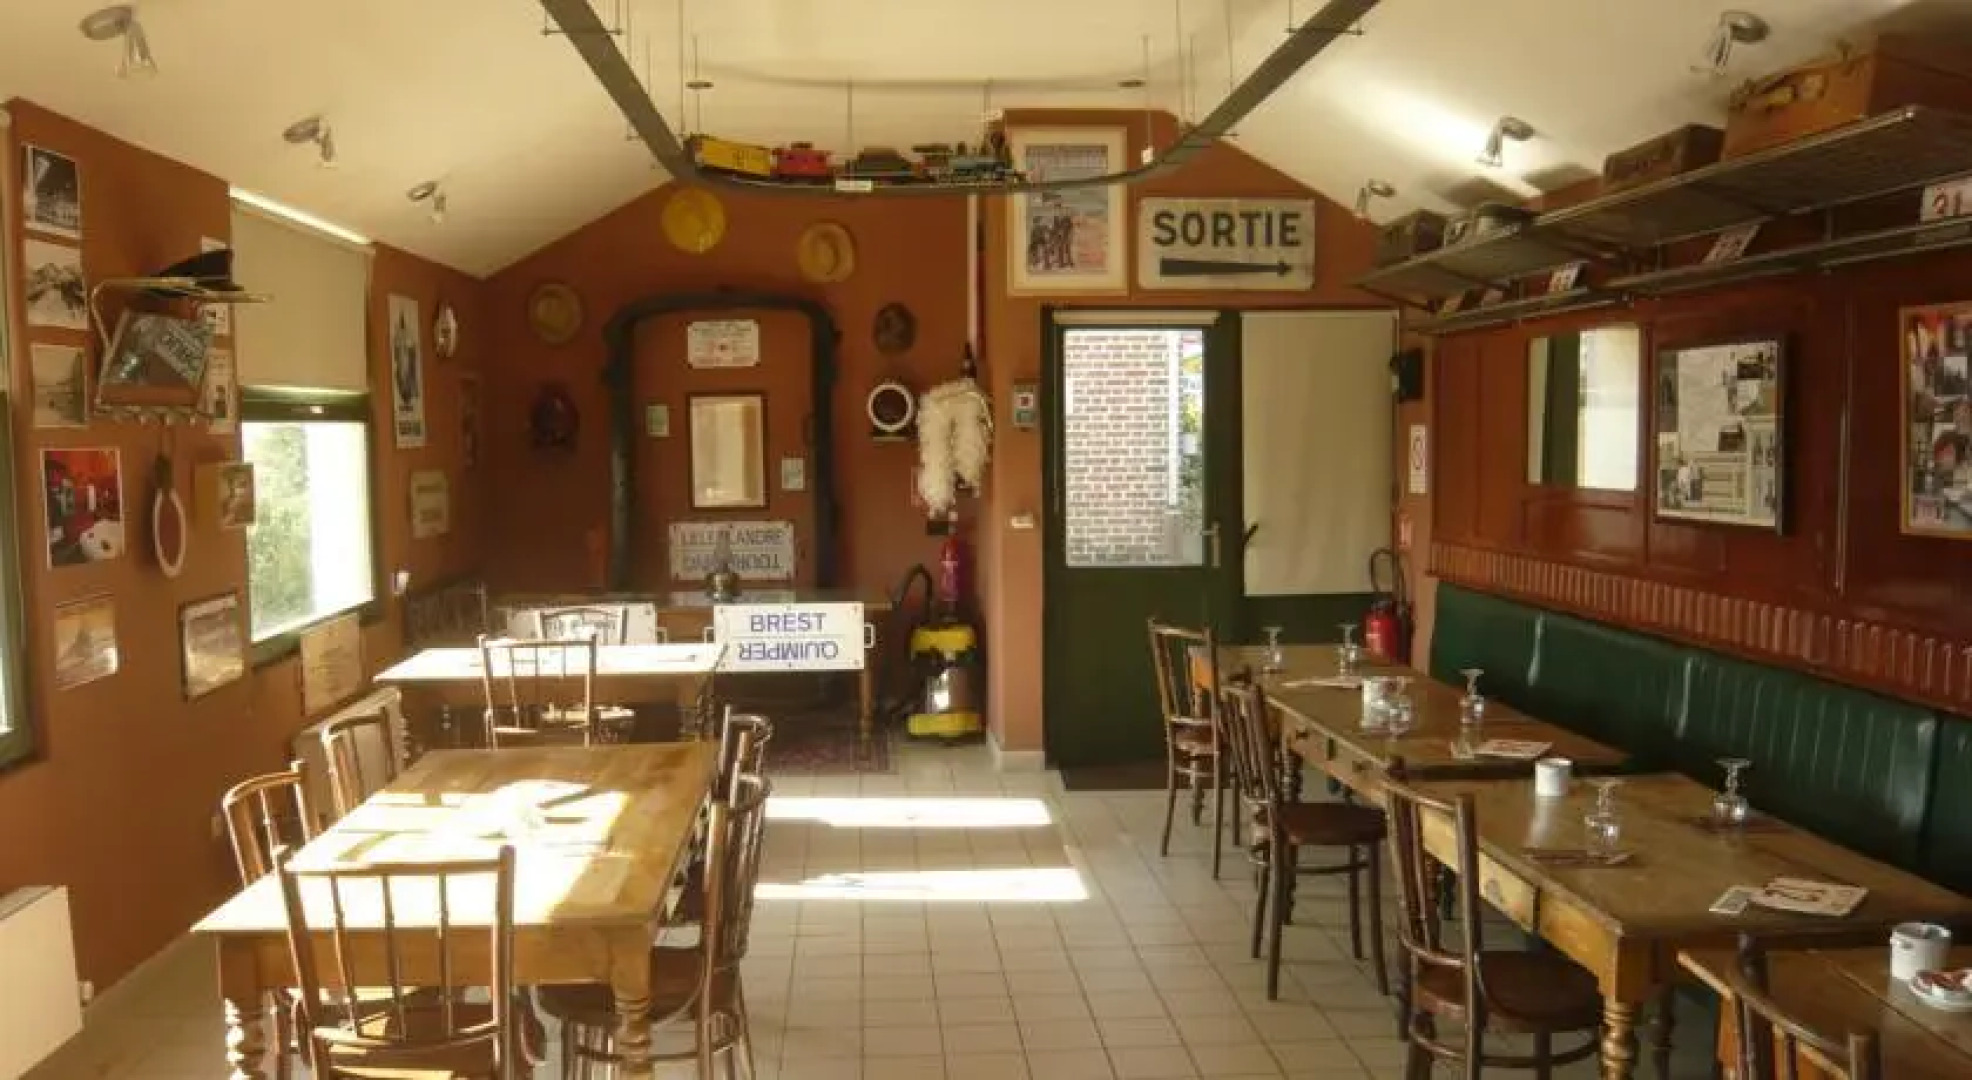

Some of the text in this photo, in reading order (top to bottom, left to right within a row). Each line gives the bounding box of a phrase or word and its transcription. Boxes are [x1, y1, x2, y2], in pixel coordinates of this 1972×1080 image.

[1153, 211, 1301, 247] SORTIE
[750, 613, 827, 633] BREST
[738, 640, 839, 661] QUIMPER
